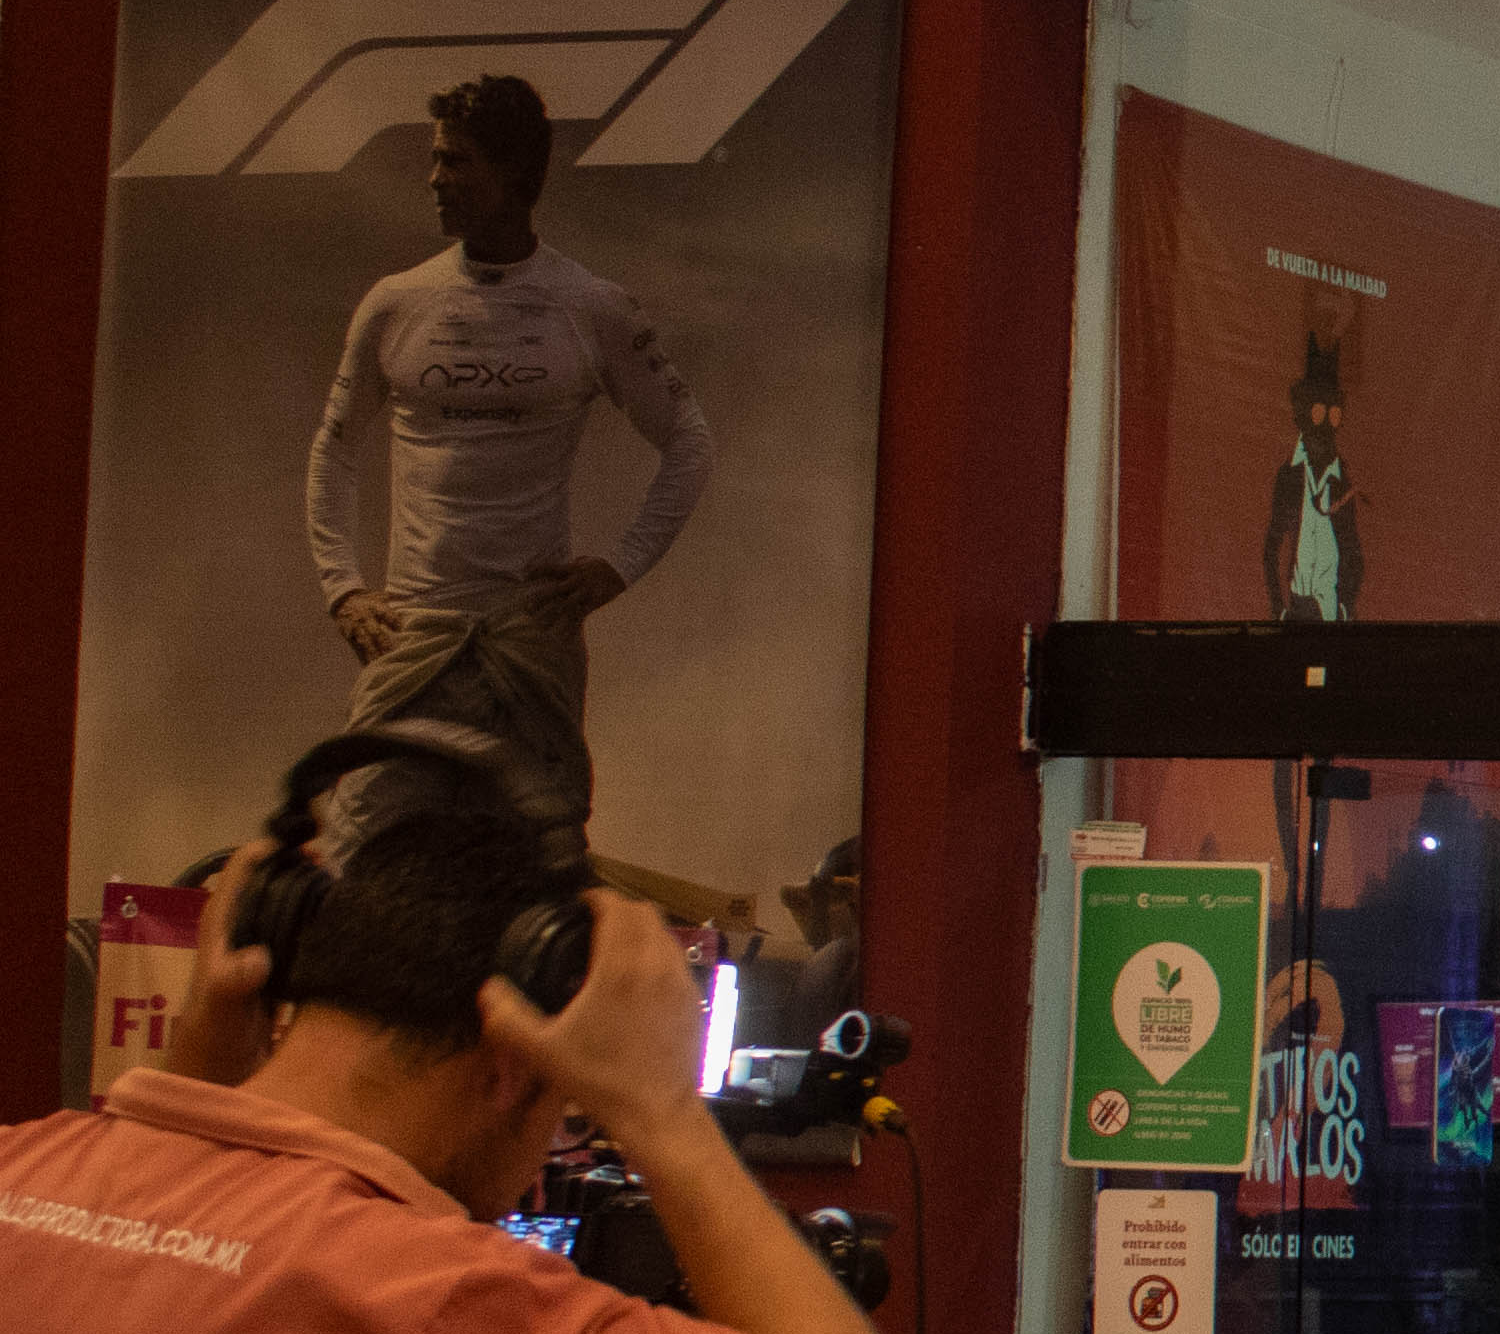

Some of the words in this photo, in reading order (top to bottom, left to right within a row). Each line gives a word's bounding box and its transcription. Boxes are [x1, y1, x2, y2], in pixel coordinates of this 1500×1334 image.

[1282, 252, 1320, 280] VUELTA
[1330, 265, 1344, 287] LA
[1345, 270, 1388, 299] MALDAD
[1141, 1007, 1193, 1023] LIBRE
[1158, 1024, 1192, 1034] HUMO
[1124, 1220, 1187, 1233] Prohibido
[1122, 1240, 1160, 1249] entrar
[1164, 1240, 1187, 1249] con
[1312, 1234, 1355, 1258] CINES
[1124, 1254, 1187, 1267] alimentos
